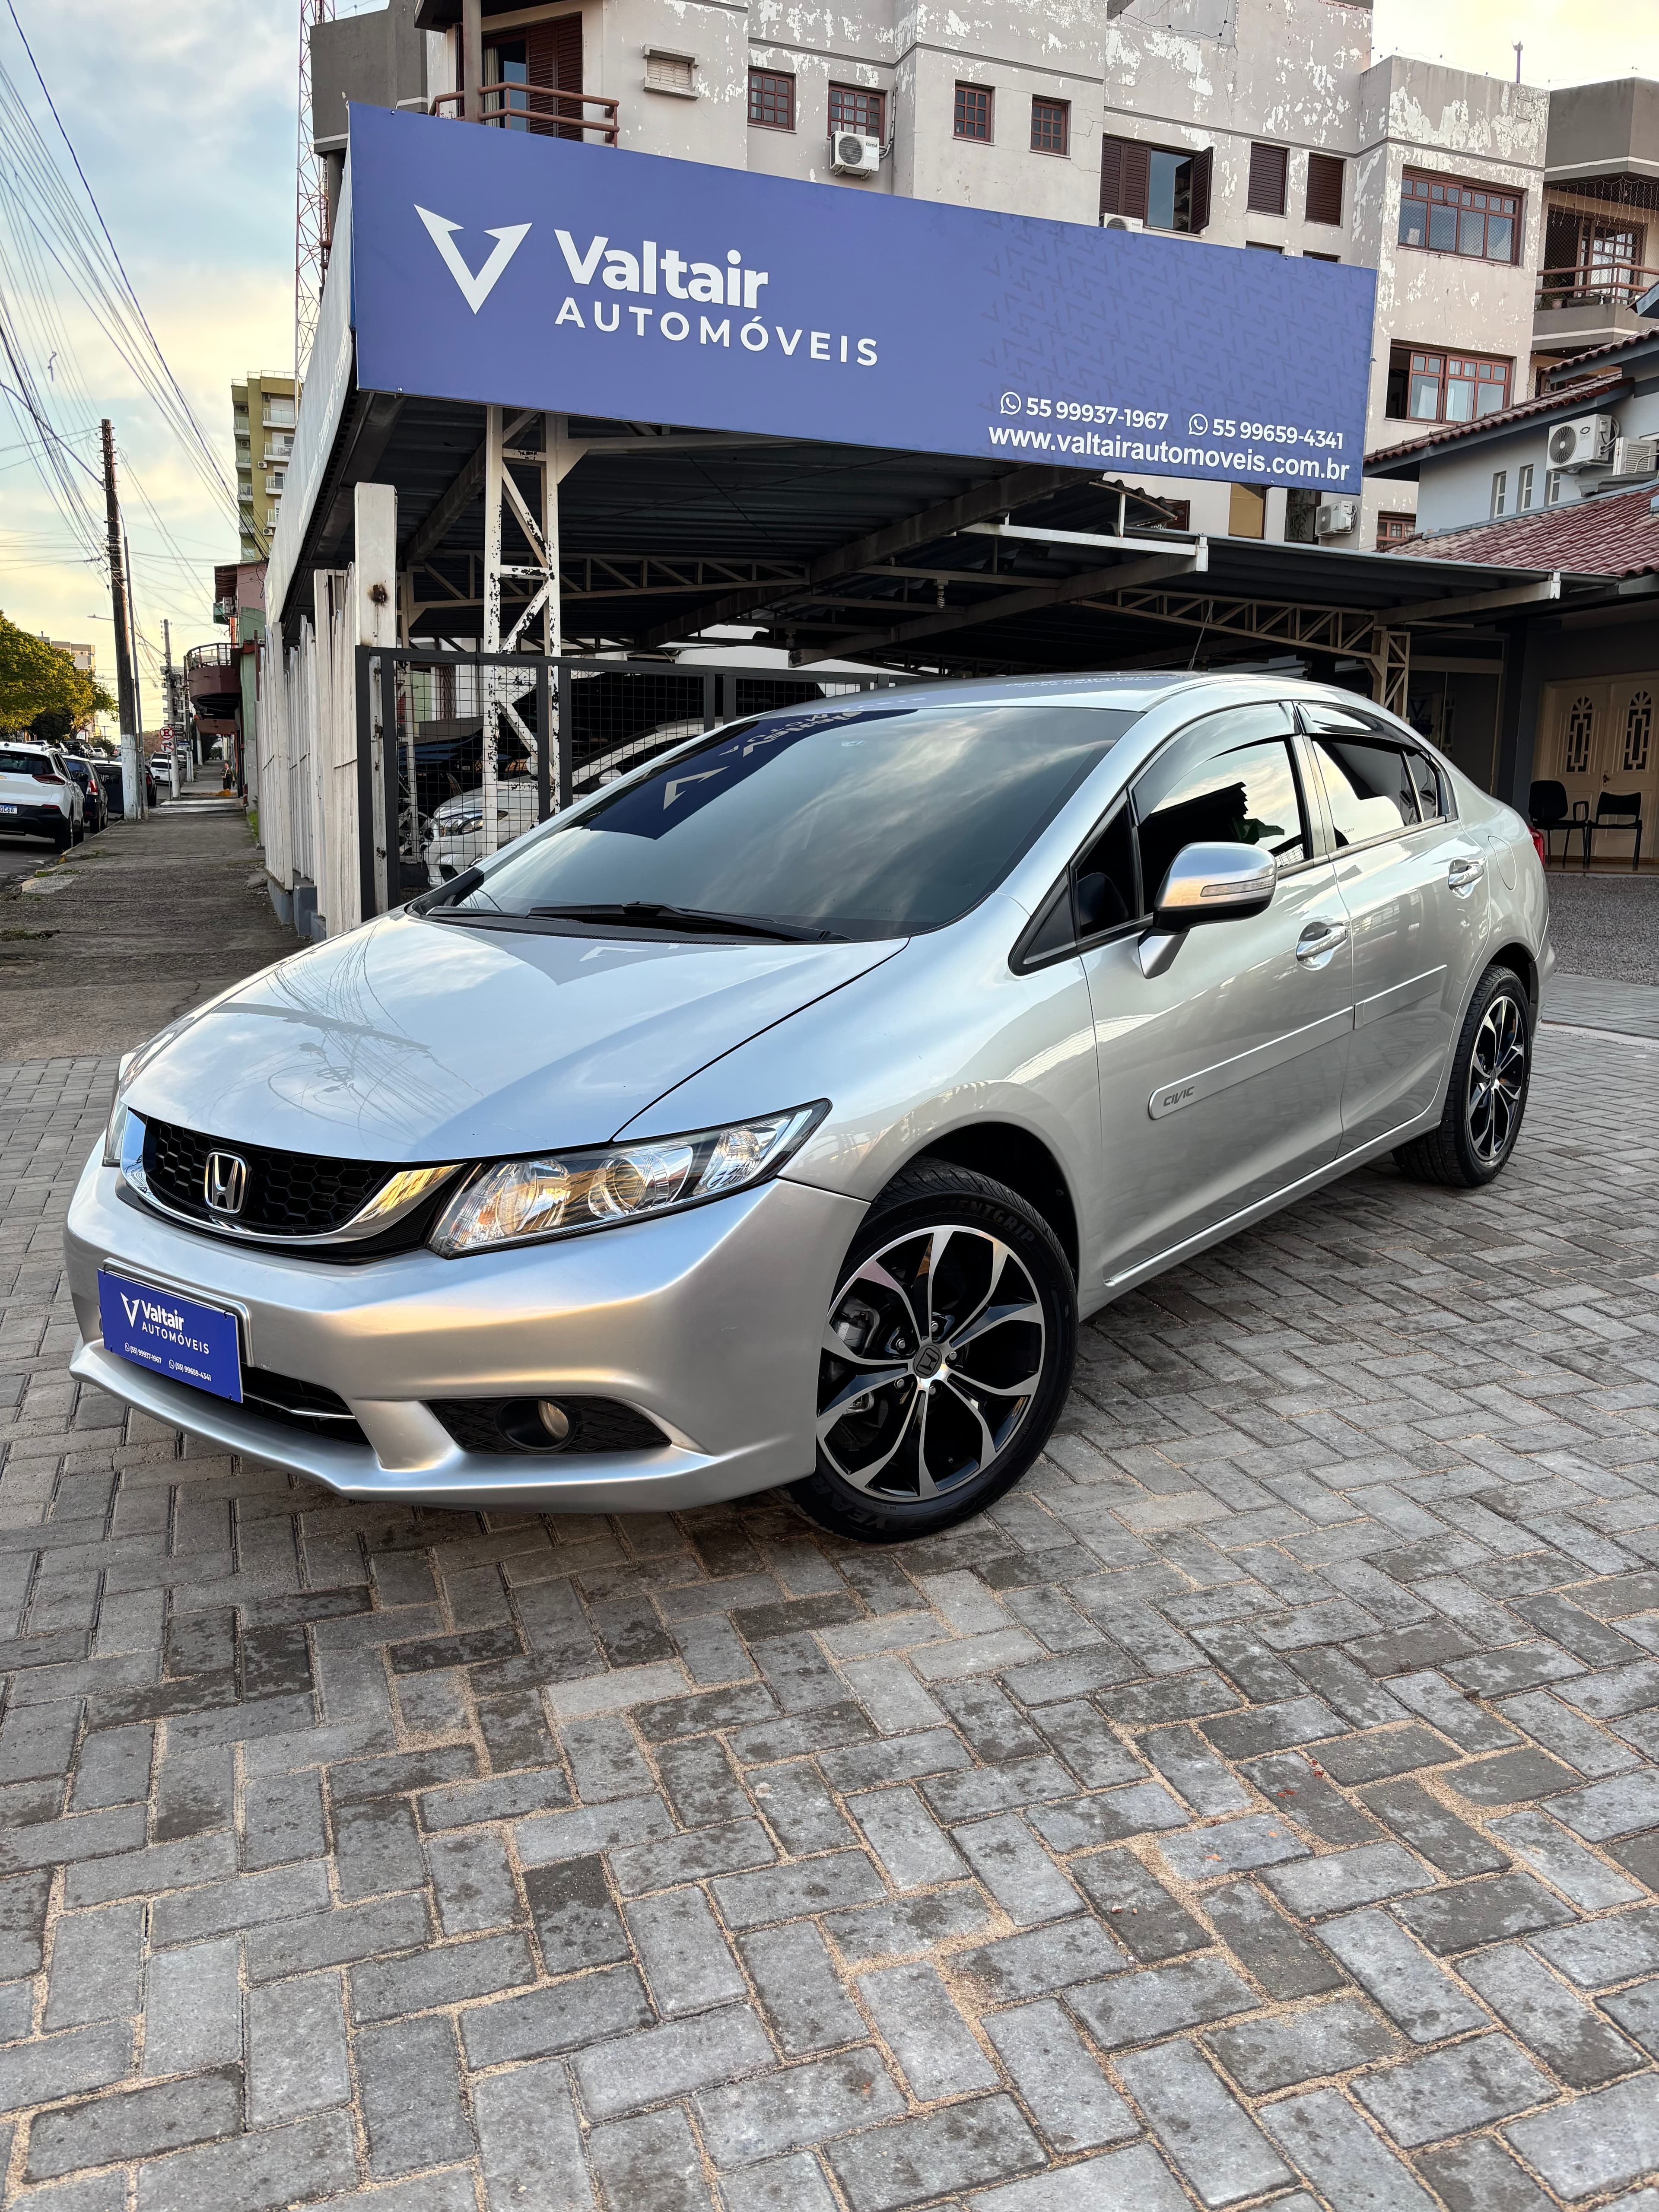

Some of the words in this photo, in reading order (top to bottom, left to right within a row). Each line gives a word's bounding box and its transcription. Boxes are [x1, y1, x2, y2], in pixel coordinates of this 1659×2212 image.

[554, 229, 769, 309] Valtair
[555, 297, 877, 366] AUTOMÓVEIS
[1026, 397, 1052, 417] 55
[1056, 401, 1169, 430] 99937-1967
[1212, 418, 1236, 437] 55
[1240, 422, 1343, 450] 99659-4341
[988, 426, 1351, 481] www.valtairautomoveis.com.br
[1163, 1086, 1195, 1107] CIVIC
[141, 1300, 184, 1331] Valtair
[142, 1321, 210, 1355] AUTOMÓVEIS
[138, 1349, 162, 1364] 99937-1967
[175, 1362, 184, 1373] (55)
[184, 1366, 212, 1382] 99659-4341
